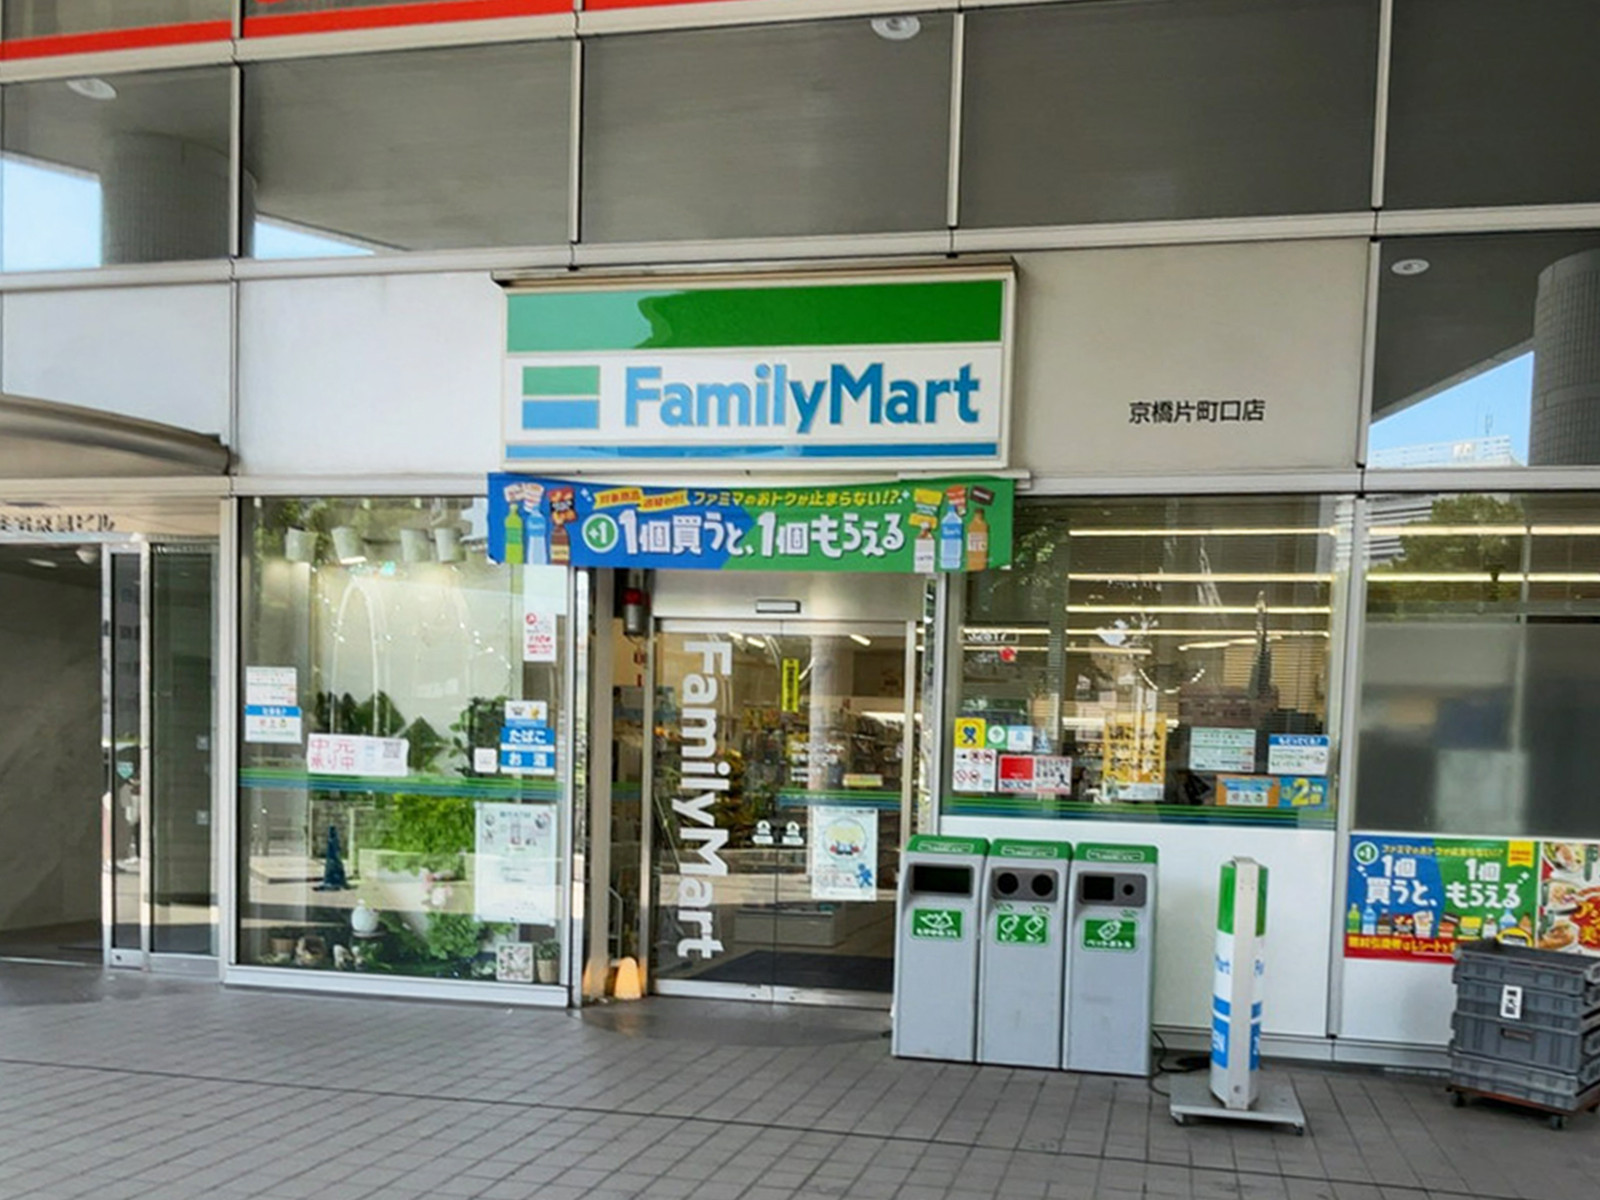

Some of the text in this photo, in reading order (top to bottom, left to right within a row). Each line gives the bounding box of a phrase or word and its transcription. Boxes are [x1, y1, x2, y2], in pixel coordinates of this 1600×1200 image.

[624, 362, 981, 434] FamilyMart
[1128, 398, 1266, 425] 京橋片町口店
[509, 728, 547, 745] たばこ
[671, 640, 733, 959] FamilyMart
[1381, 855, 1416, 878] 1個
[1465, 857, 1501, 882] 1個
[1366, 876, 1438, 906] 買うと、
[1445, 882, 1521, 909] もらえる
